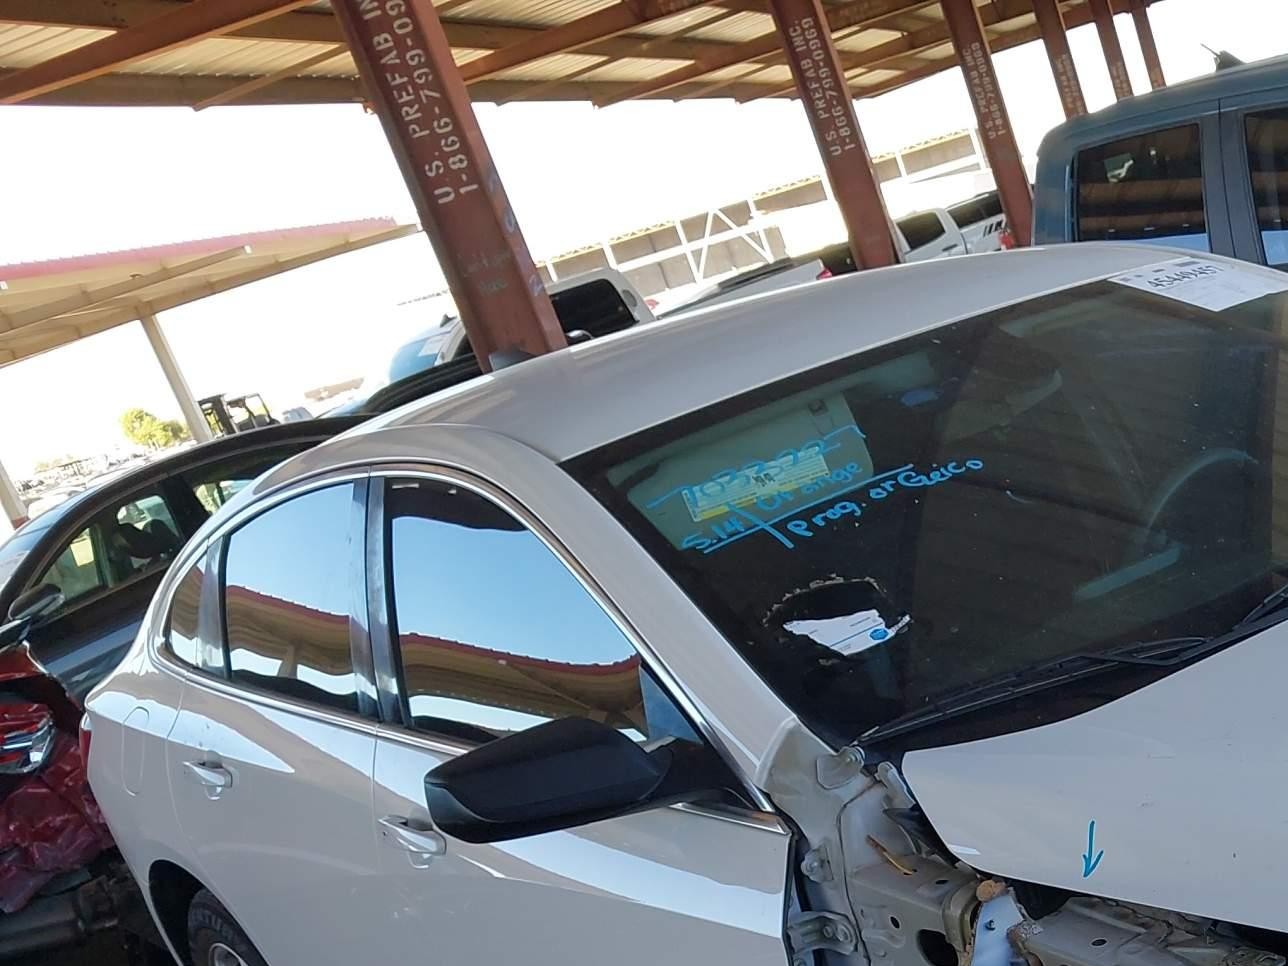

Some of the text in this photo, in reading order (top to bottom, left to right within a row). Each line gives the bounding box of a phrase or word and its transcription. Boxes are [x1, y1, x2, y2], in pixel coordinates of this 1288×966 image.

[371, 32, 431, 138] PREFAB
[800, 58, 831, 119] PREFAB
[869, 479, 897, 499] or
